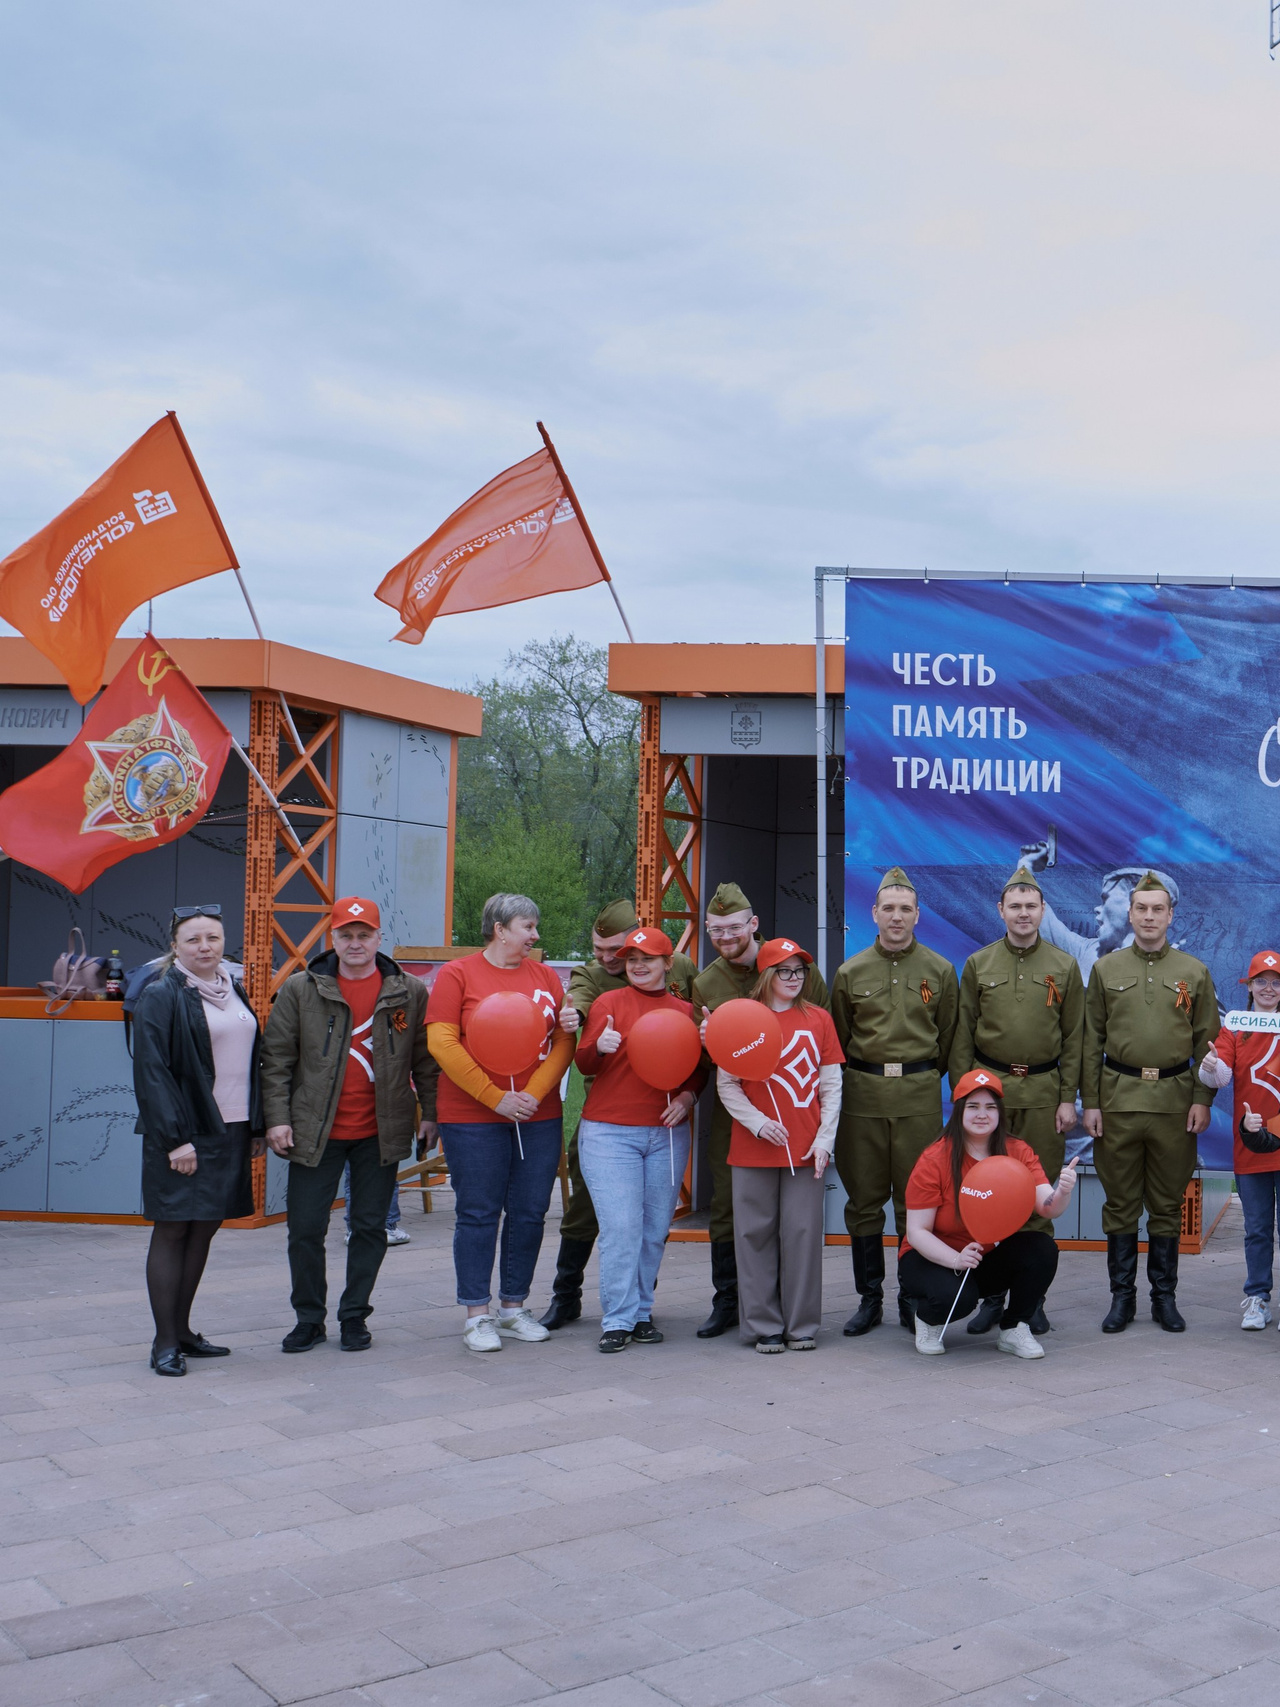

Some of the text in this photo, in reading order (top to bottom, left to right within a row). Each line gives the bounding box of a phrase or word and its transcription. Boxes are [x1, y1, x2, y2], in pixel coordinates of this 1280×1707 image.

[891, 652, 997, 687] ЧЕСТЬ
[0, 707, 70, 729] КОВИЧ
[892, 704, 1028, 740] ПАМЯТЬ
[892, 756, 1062, 796] ТРАДИЦИИ
[732, 1037, 765, 1058] СИБАГРО
